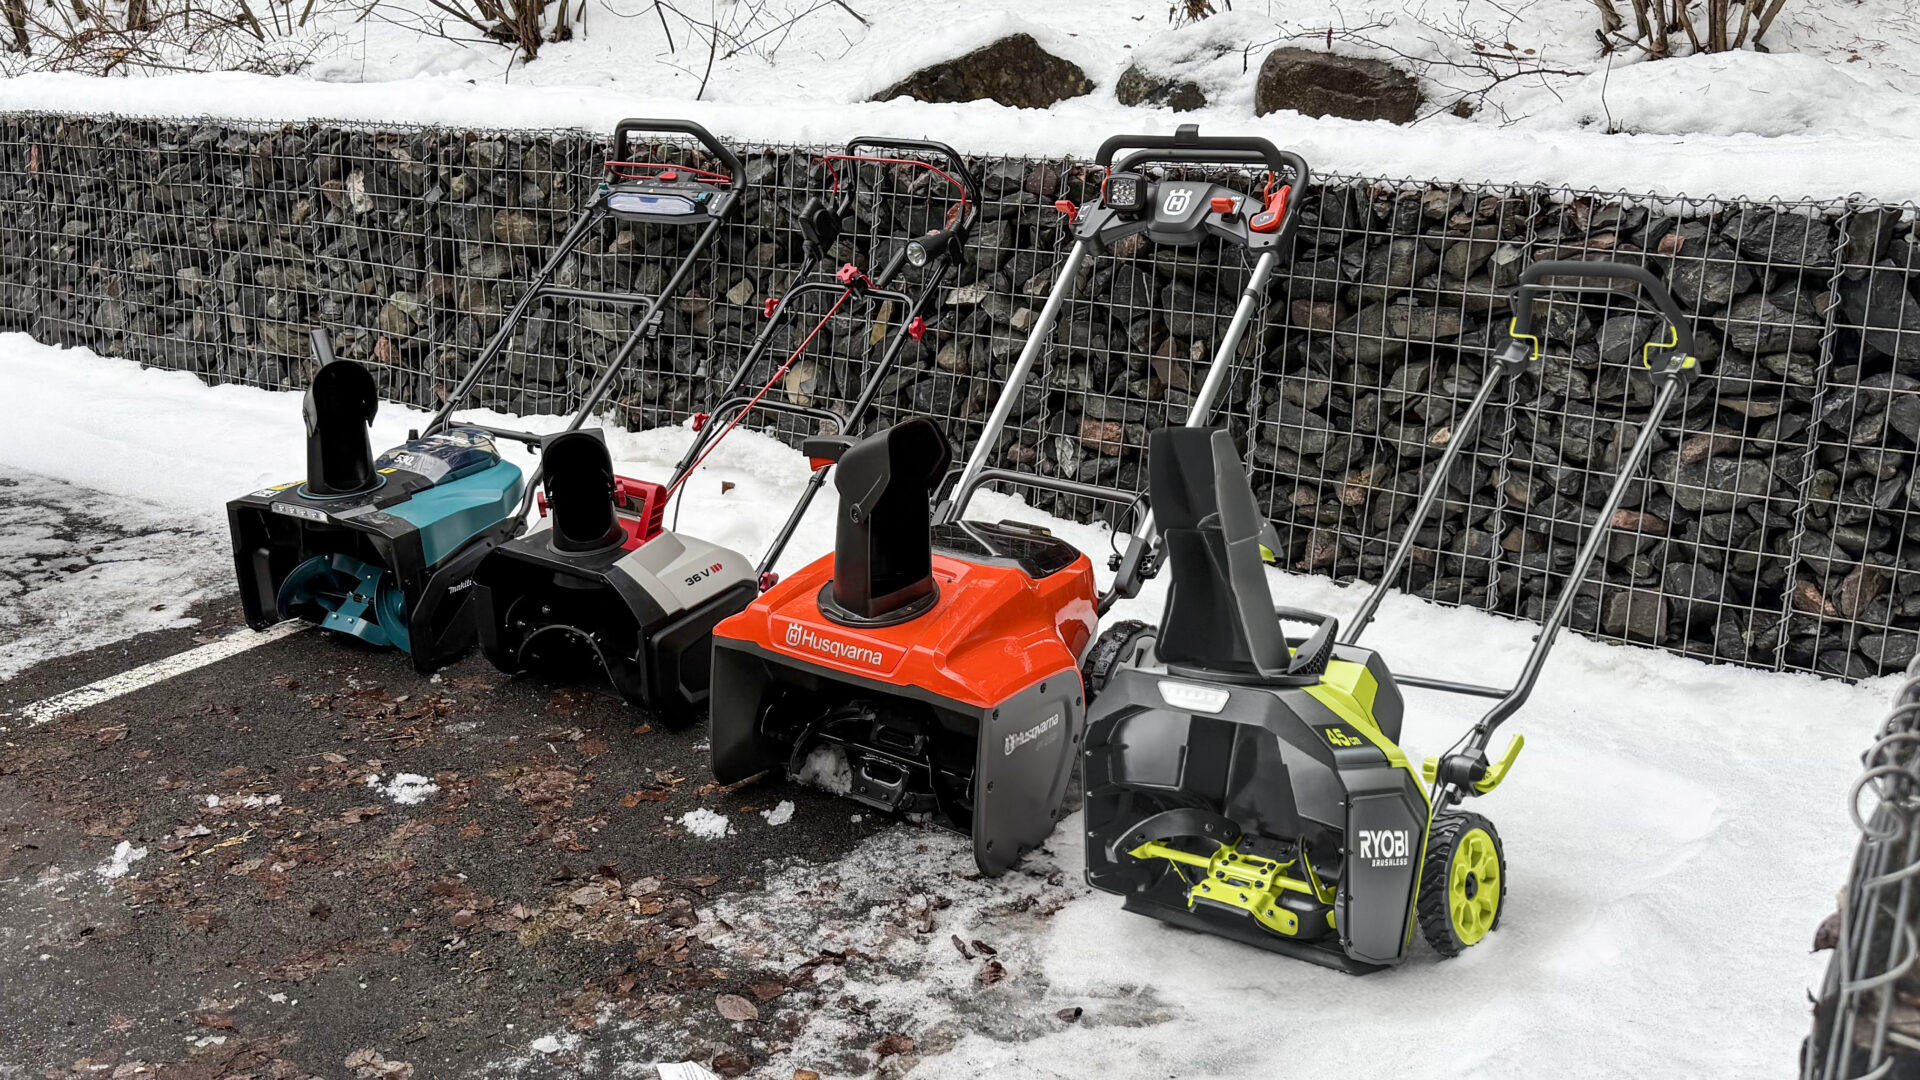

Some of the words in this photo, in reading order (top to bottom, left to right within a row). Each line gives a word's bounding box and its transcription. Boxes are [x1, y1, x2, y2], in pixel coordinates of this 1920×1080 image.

[685, 573, 702, 586] 36
[700, 568, 710, 577] V
[801, 629, 883, 666] Husqvarna
[1359, 829, 1409, 859] RYOBI
[1371, 857, 1408, 867] BRUSHLESS
